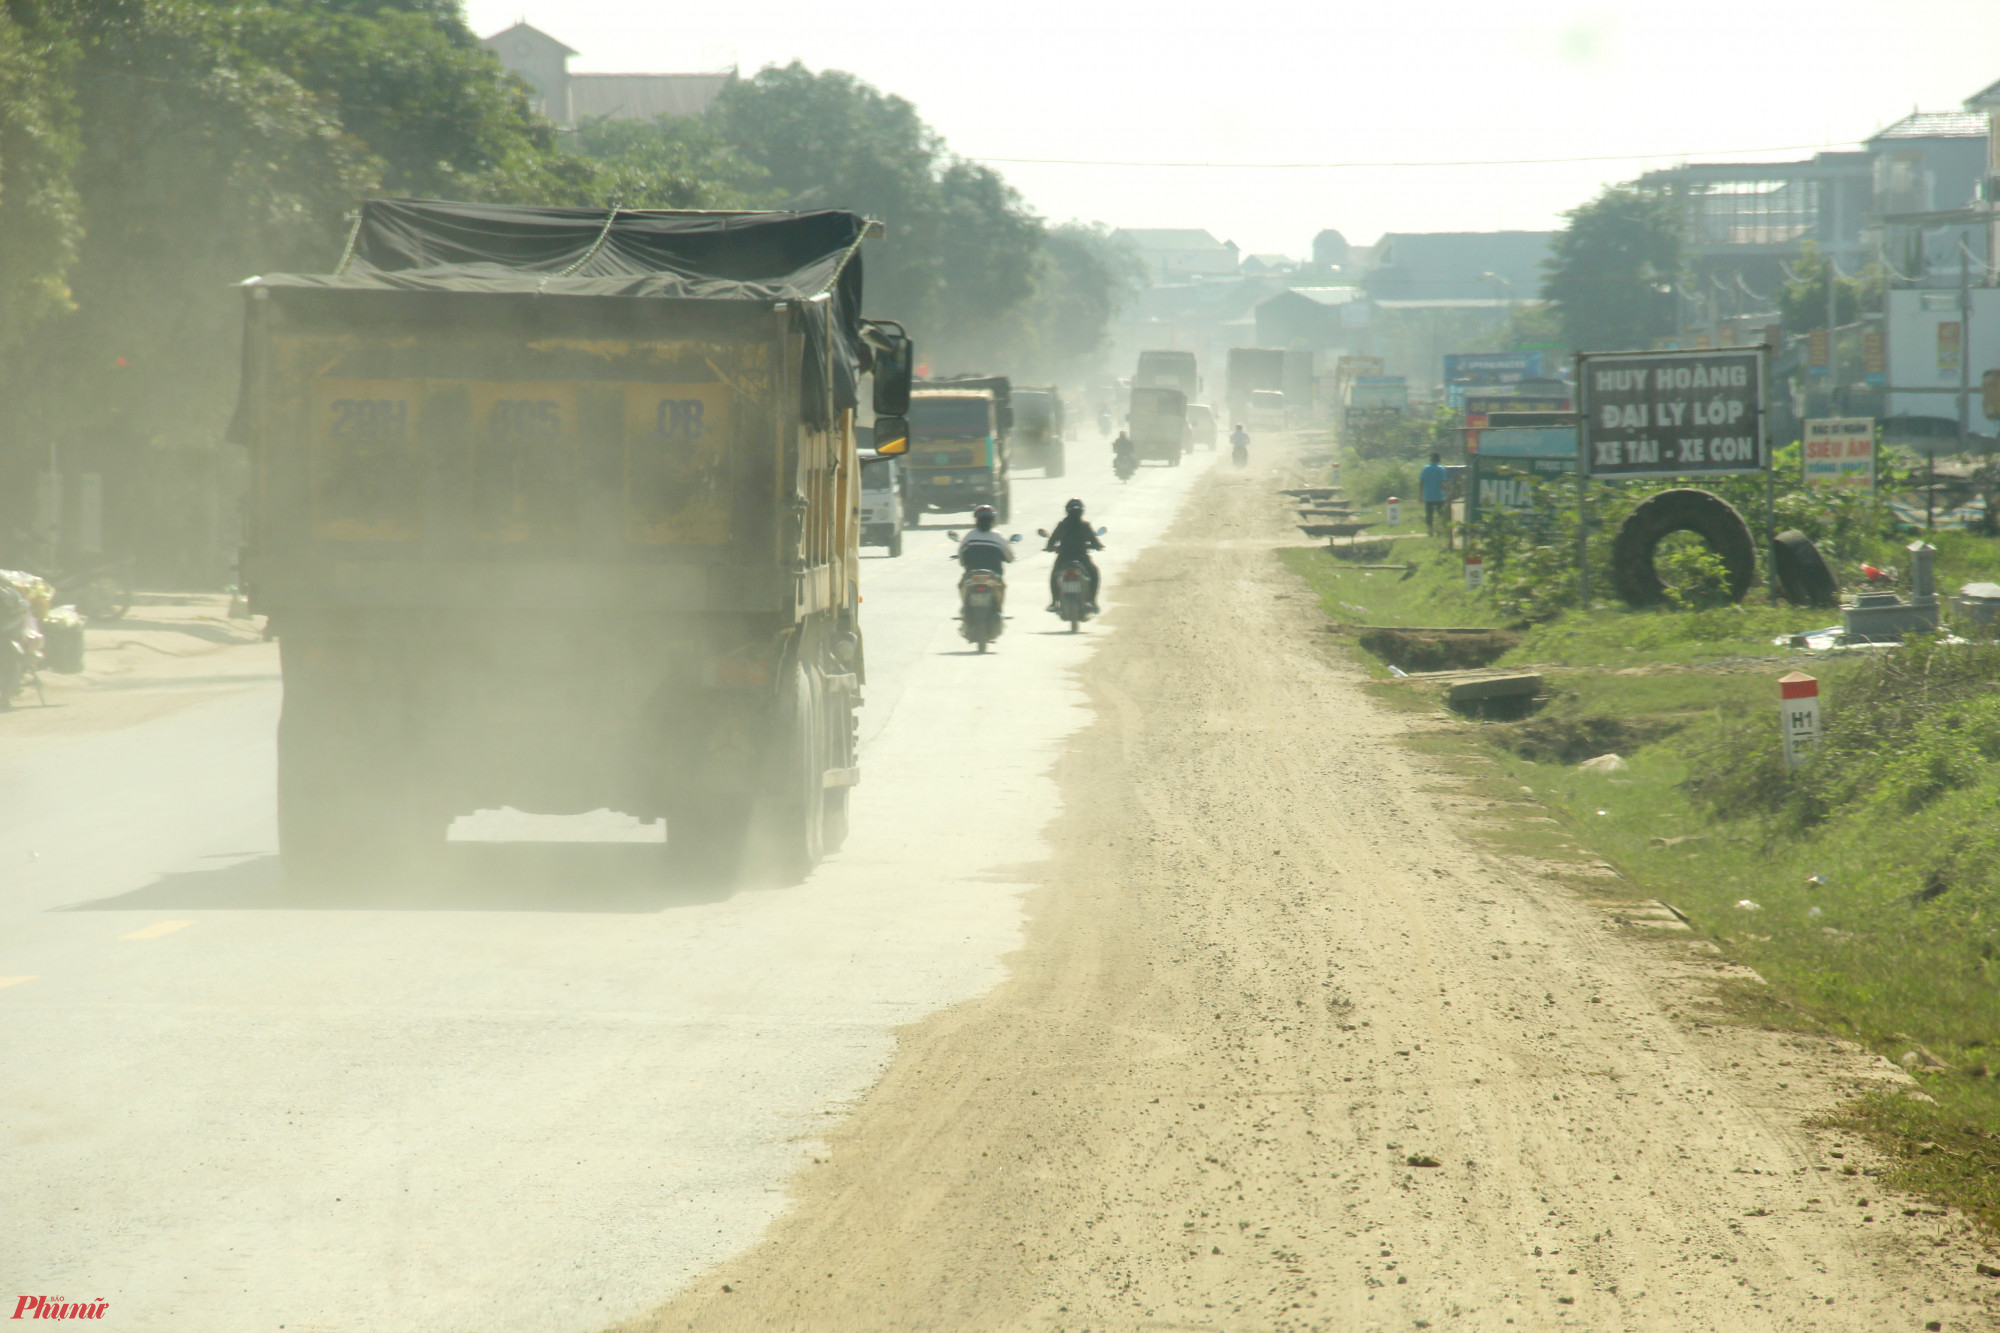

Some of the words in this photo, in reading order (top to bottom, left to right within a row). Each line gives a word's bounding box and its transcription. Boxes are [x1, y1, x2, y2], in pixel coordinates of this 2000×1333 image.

[1596, 369, 1648, 391] HUY
[1656, 363, 1747, 390] HOÀNG
[1601, 403, 1649, 434] ĐẠI
[1656, 397, 1687, 427] LÝ
[1694, 393, 1744, 426] LỐP
[1594, 441, 1622, 465] XE
[1678, 439, 1705, 462] XE
[1710, 437, 1752, 461] CON
[1791, 711, 1812, 728] H1
